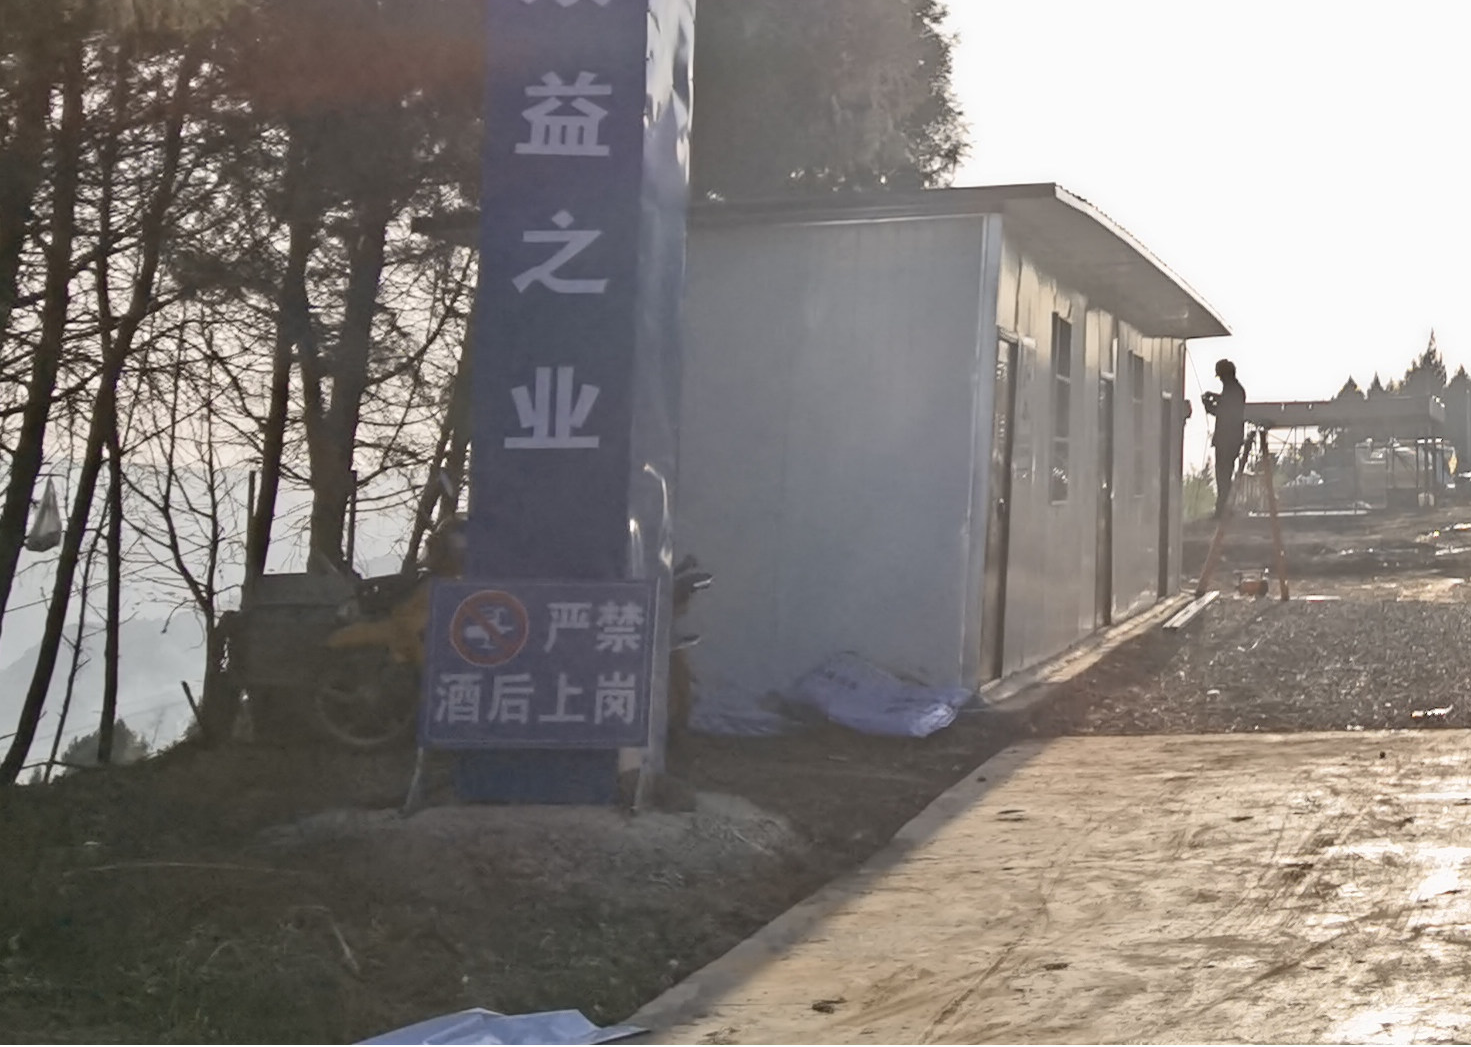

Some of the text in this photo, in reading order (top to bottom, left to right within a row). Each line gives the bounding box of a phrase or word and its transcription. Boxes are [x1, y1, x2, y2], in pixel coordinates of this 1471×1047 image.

[543, 601, 645, 652] 严禁
[435, 671, 637, 725] 酒后上岗
